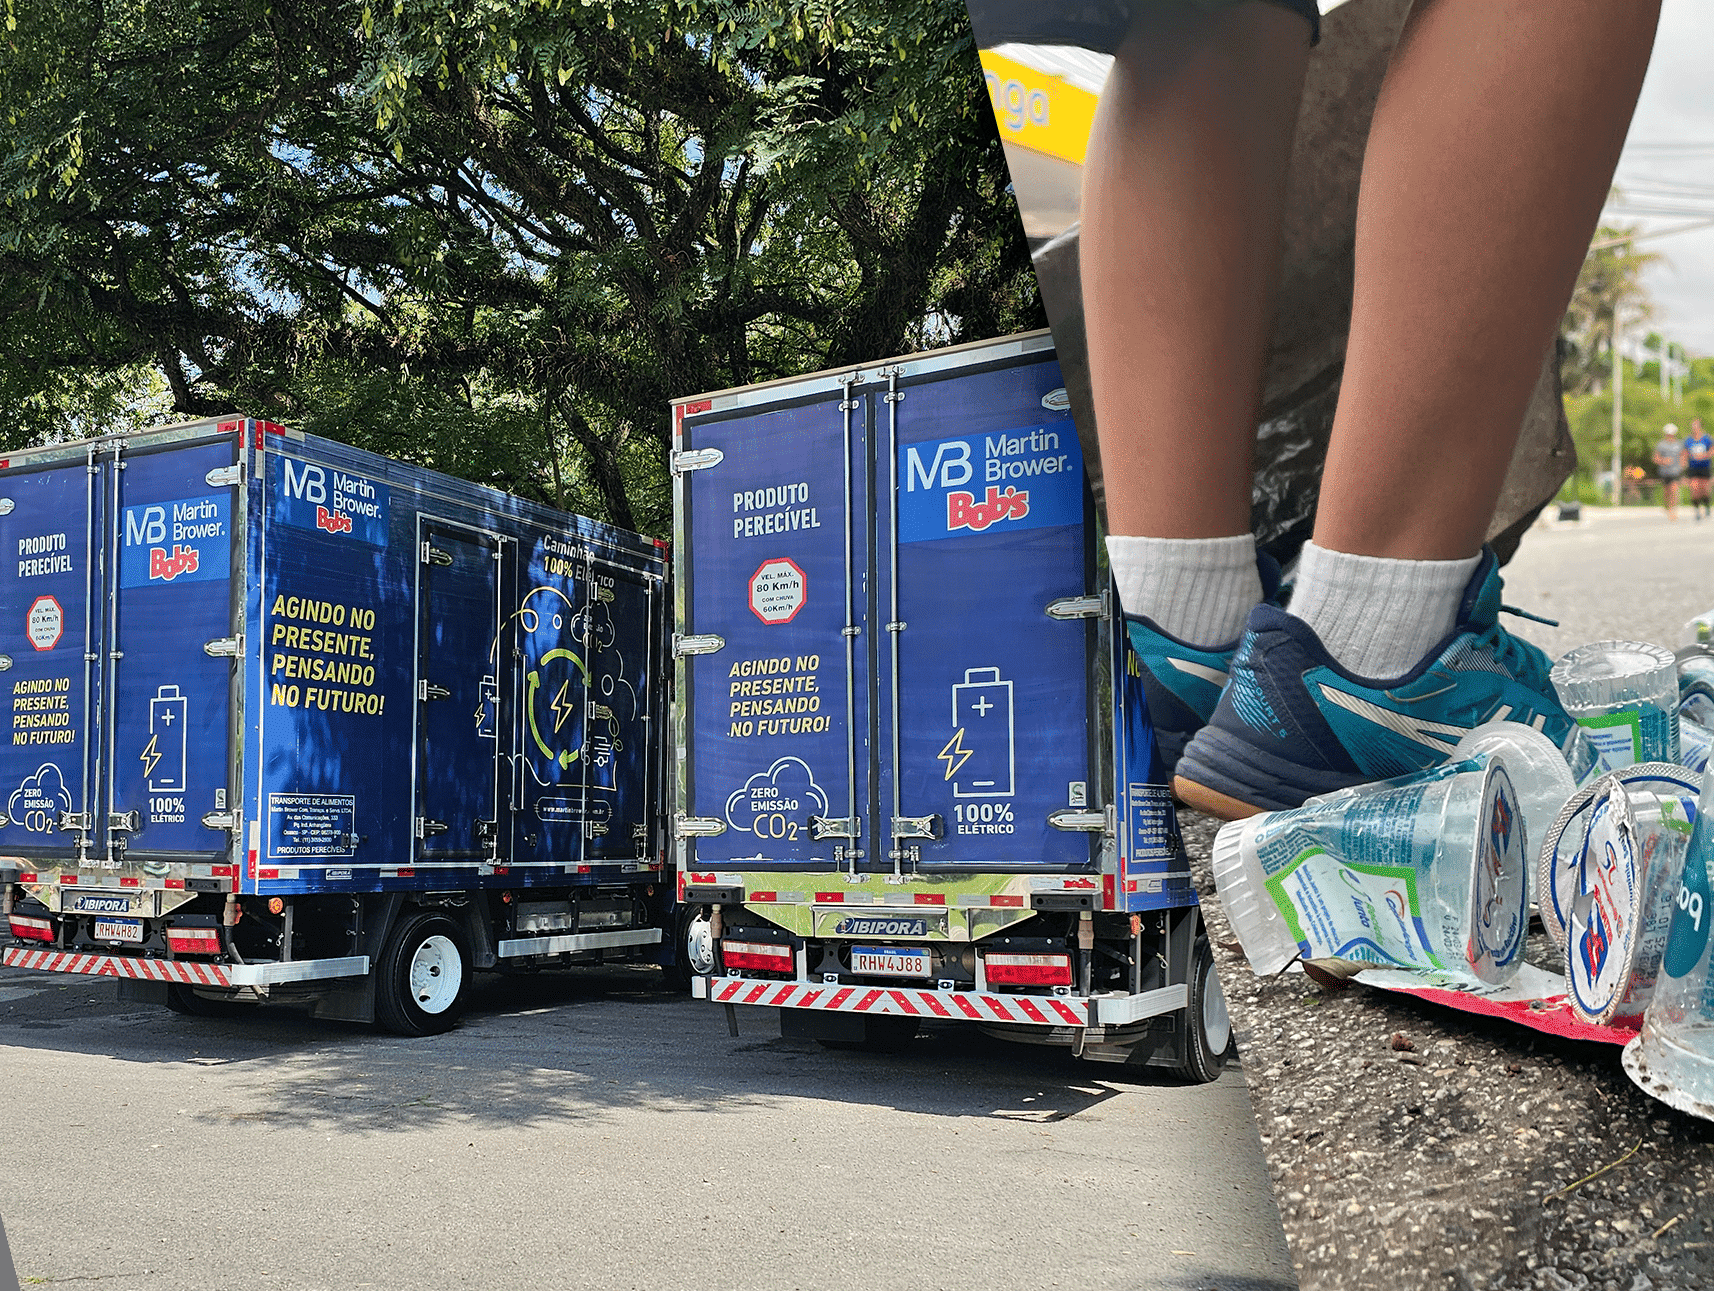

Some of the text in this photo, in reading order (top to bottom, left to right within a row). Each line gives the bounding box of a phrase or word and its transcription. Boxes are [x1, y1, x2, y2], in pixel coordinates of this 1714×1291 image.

[985, 428, 1059, 459] Martin
[907, 440, 973, 492] MB
[985, 454, 1073, 483] Brower.
[284, 459, 327, 504] MB
[333, 471, 375, 500] Martin
[333, 490, 382, 519] Brower.
[733, 481, 809, 512] PRODUTO
[173, 500, 218, 522] Martin
[316, 505, 352, 533] Bob's
[946, 485, 1030, 532] Bob's
[126, 506, 166, 546] MB
[173, 520, 225, 541] Brower.
[733, 508, 821, 539] PERECÍVEL
[18, 532, 66, 556] PRODUTO
[544, 534, 595, 561] Caminhão
[18, 555, 73, 577] PERECÍVEL
[150, 545, 199, 581] Bob's
[544, 556, 573, 578] 100%
[756, 580, 799, 592] 80 Km/h
[271, 594, 376, 631] AGINDO NO
[763, 604, 793, 612] 60Km/h
[272, 623, 375, 661] PRESENTE,
[272, 653, 375, 687] PENSANDO
[729, 654, 820, 678] AGINDO NO
[13, 678, 70, 694] AGINDO NO
[730, 676, 820, 698] PRESENTE,
[13, 695, 69, 711] PRESENTE,
[271, 684, 385, 716] NO FUTURO!
[730, 696, 820, 718] PENSANDO
[13, 712, 70, 728] PENSANDO
[730, 716, 831, 738] NO FUTURO!
[13, 729, 75, 745] NO FUTURO!
[24, 788, 42, 798] ZERO
[24, 797, 54, 809] EMISSÃO
[271, 796, 311, 805] TRANSPORTE
[751, 787, 779, 799] ZERO
[149, 797, 185, 813] 100%
[751, 798, 799, 812] EMISSÃO
[953, 803, 1014, 823] 100%
[150, 812, 185, 823] ELÉTRICO
[753, 814, 798, 841] CO2
[957, 823, 1014, 835] ELÉTRICO
[277, 846, 310, 854] PRODUTOS
[84, 898, 128, 911] IBIPORÃ
[100, 924, 137, 938] RHW4H82
[852, 919, 923, 934] IBIPORÃ
[859, 955, 922, 972] RHW4J88
